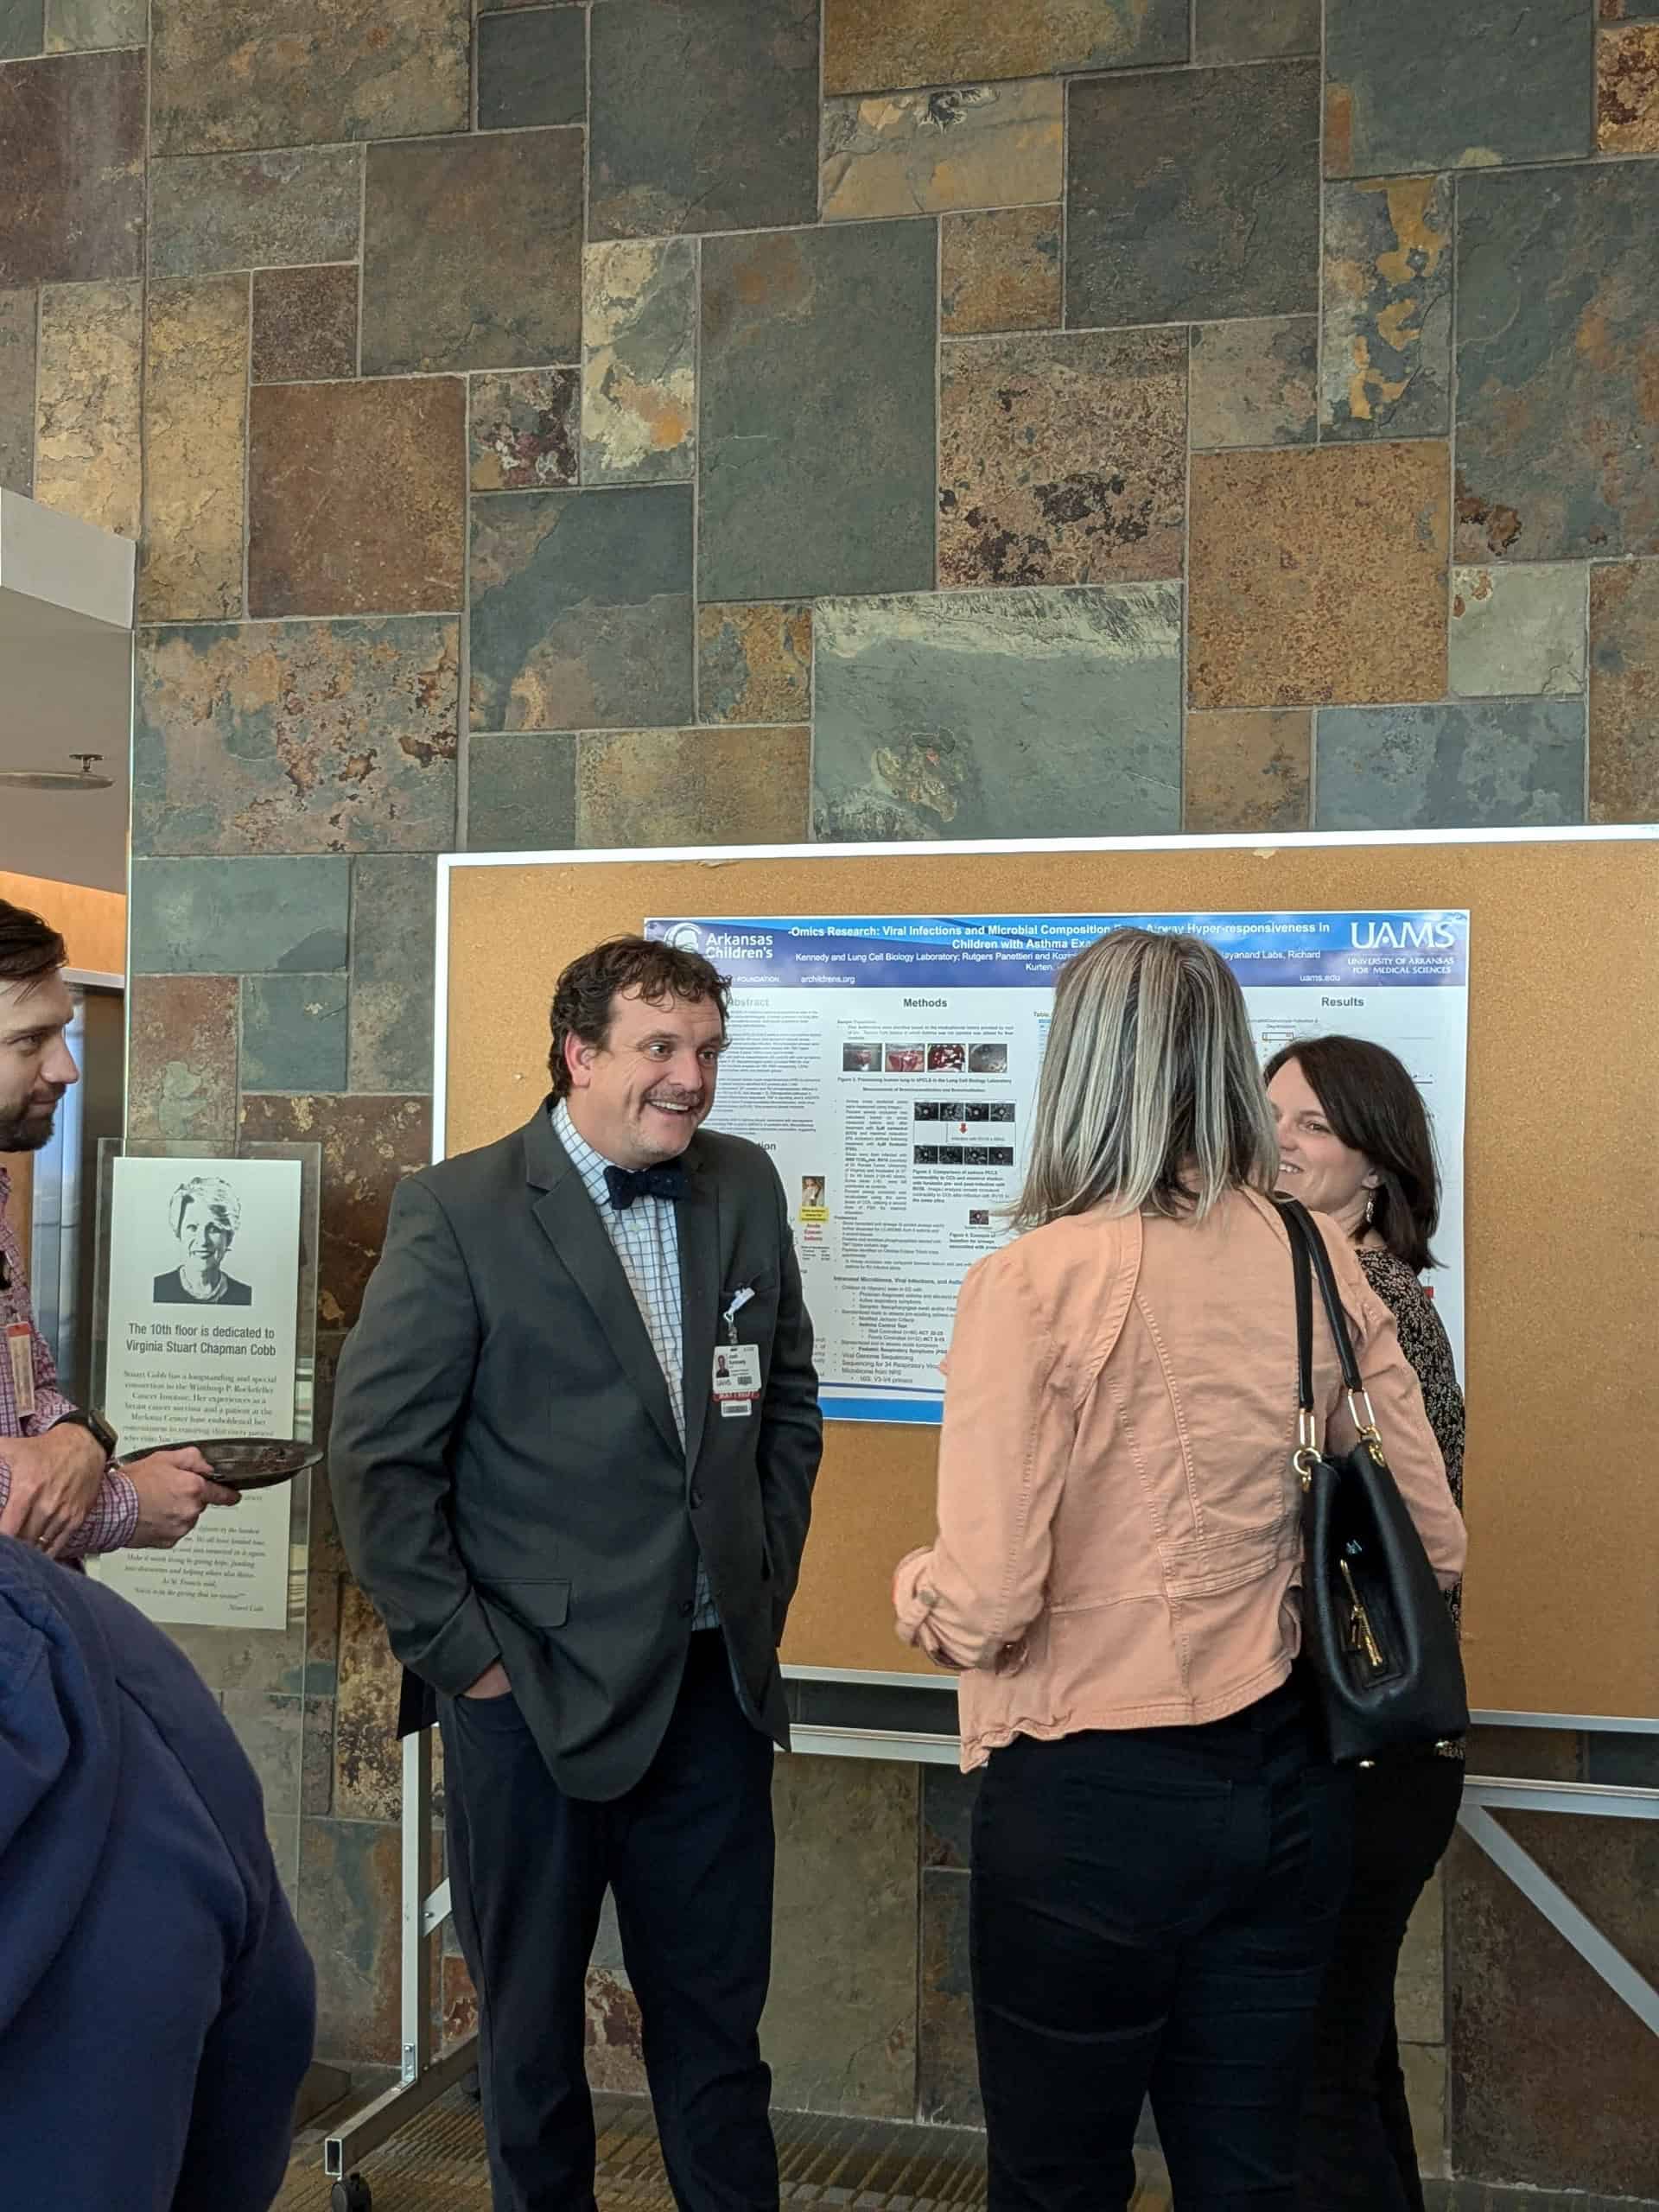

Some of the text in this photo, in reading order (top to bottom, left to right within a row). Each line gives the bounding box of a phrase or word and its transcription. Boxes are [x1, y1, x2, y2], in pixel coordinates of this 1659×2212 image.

[788, 926, 824, 936] -Omics
[827, 926, 880, 936] Research:
[883, 925, 906, 936] Viral
[910, 925, 962, 936] Infections
[964, 925, 985, 935] and
[988, 925, 1037, 935] Microbial
[1040, 925, 1110, 937] Composition
[1319, 922, 1330, 932] in
[705, 932, 773, 946] Arkansas
[1351, 920, 1455, 949] UAMS
[952, 939, 997, 949] Children
[1001, 939, 1023, 949] with
[1027, 939, 1068, 949] Asthma
[705, 946, 773, 959] Children's
[795, 953, 830, 963] Kennedy
[831, 953, 846, 962] and
[848, 953, 867, 963] Lung
[868, 952, 883, 962] Cell
[886, 952, 913, 963] Biology
[962, 952, 993, 963] Rutgers
[1035, 951, 1050, 960] and
[1288, 950, 1320, 959] Richard
[1348, 957, 1455, 965] UNIVERSITY OF ARKANSAS
[1352, 966, 1452, 975] FOR MEDICAL SCIENCES
[800, 975, 856, 985] archildrens.org
[1300, 974, 1341, 983] uams.edu
[727, 996, 769, 1007] Abstract
[903, 998, 948, 1008] Methods
[1321, 997, 1364, 1007] Results
[129, 1323, 275, 1338] The 10th floor is dedicated to
[125, 1340, 276, 1356] Virginia Stuart Chapman Cobb
